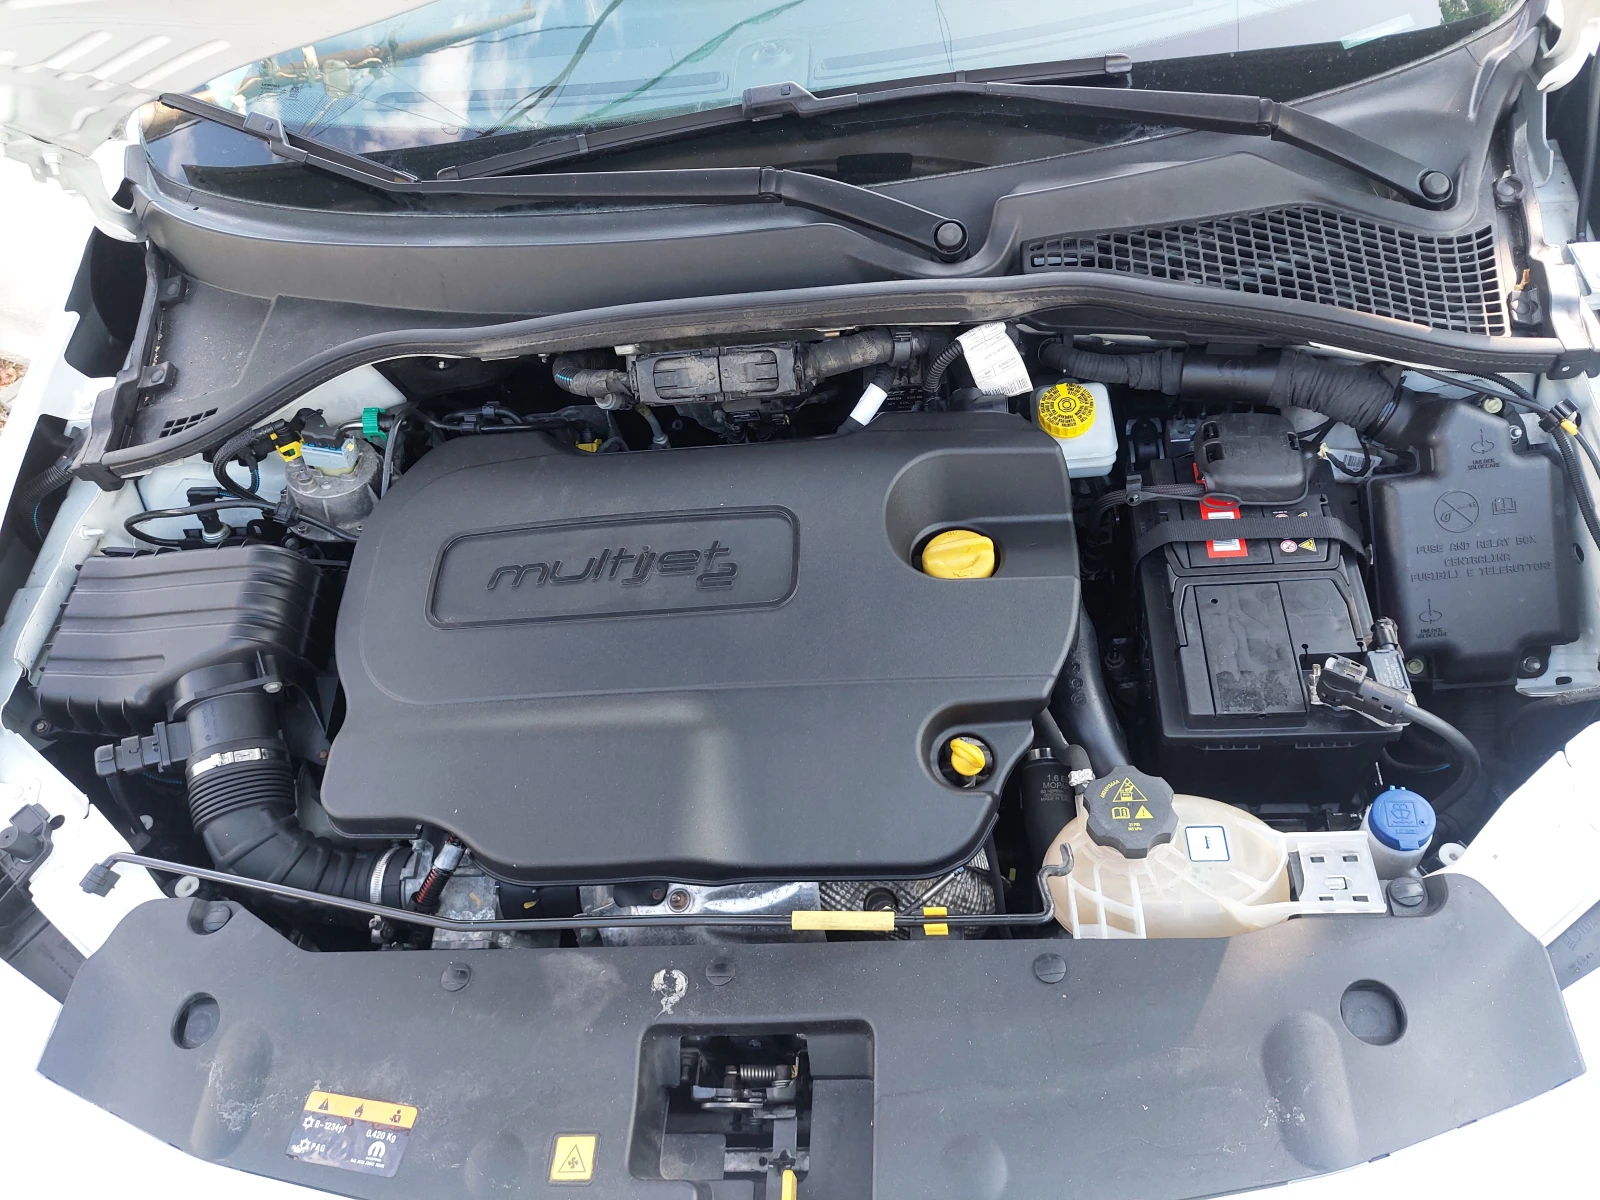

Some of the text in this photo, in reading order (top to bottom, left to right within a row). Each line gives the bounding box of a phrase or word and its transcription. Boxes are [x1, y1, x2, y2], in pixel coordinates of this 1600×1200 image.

[1416, 535, 1538, 555] FUSE AND RELAY BOX
[486, 540, 731, 591] multijet
[1444, 553, 1511, 567] CENTRALINA
[1410, 570, 1459, 582] FUSIBILI
